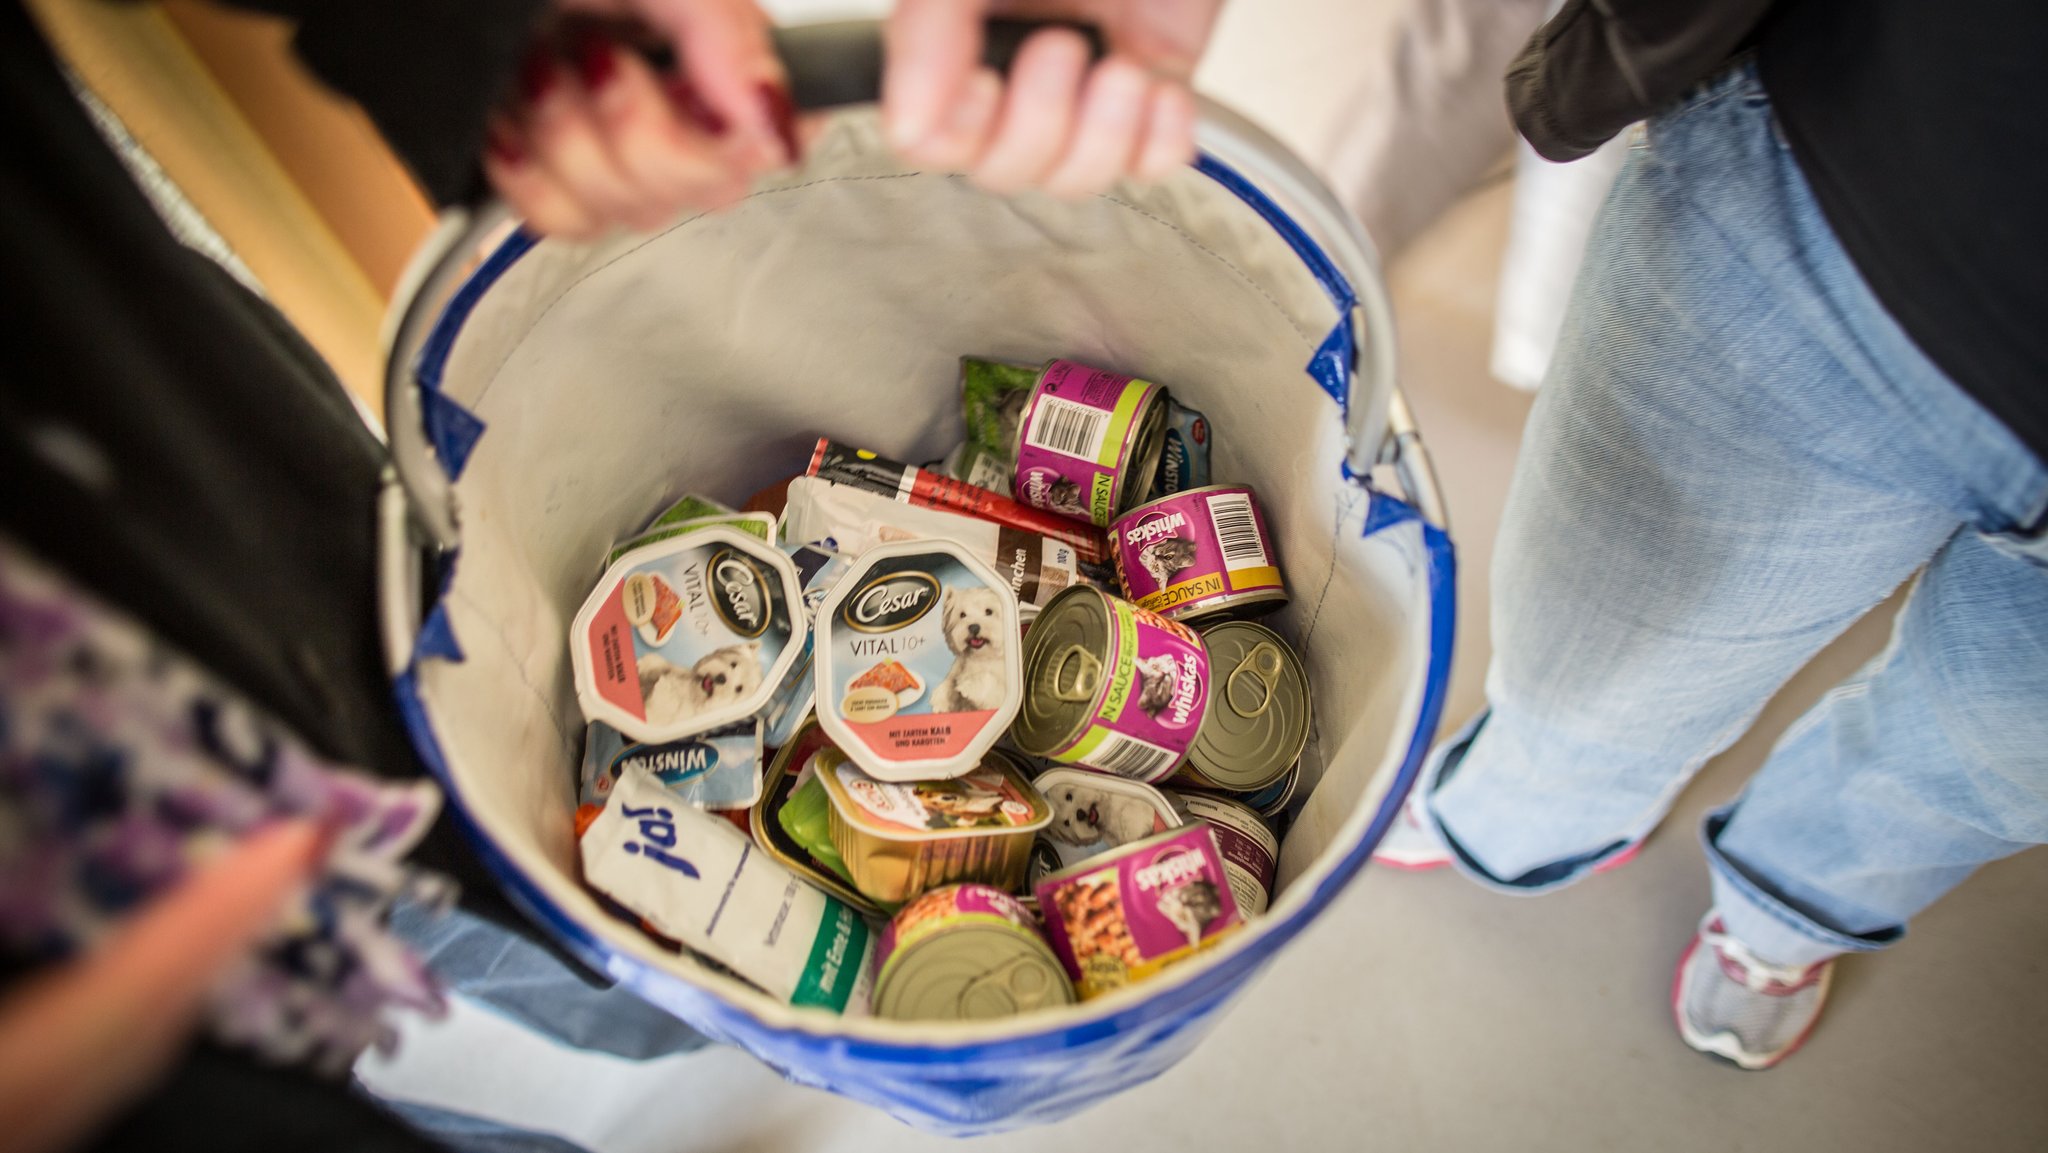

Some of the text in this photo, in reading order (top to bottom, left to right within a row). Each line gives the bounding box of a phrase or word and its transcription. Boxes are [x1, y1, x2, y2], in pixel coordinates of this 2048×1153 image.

[1099, 472, 1112, 484] IN
[1125, 511, 1186, 547] whiskas
[682, 562, 703, 613] VITAL
[716, 559, 760, 628] Cesar
[855, 584, 930, 624] Cesar
[1164, 583, 1202, 606] SAUCE
[1203, 577, 1222, 593] IN
[850, 636, 927, 658] VITAL 10+
[1101, 702, 1115, 721] IN
[1109, 659, 1131, 703] SAUCE
[1172, 653, 1198, 725] whiskas
[888, 725, 952, 739] MIT ZARTEM KALB
[895, 737, 946, 748] UND KAROTTEN
[621, 802, 701, 881] ja!
[1135, 847, 1207, 892] whiskas
